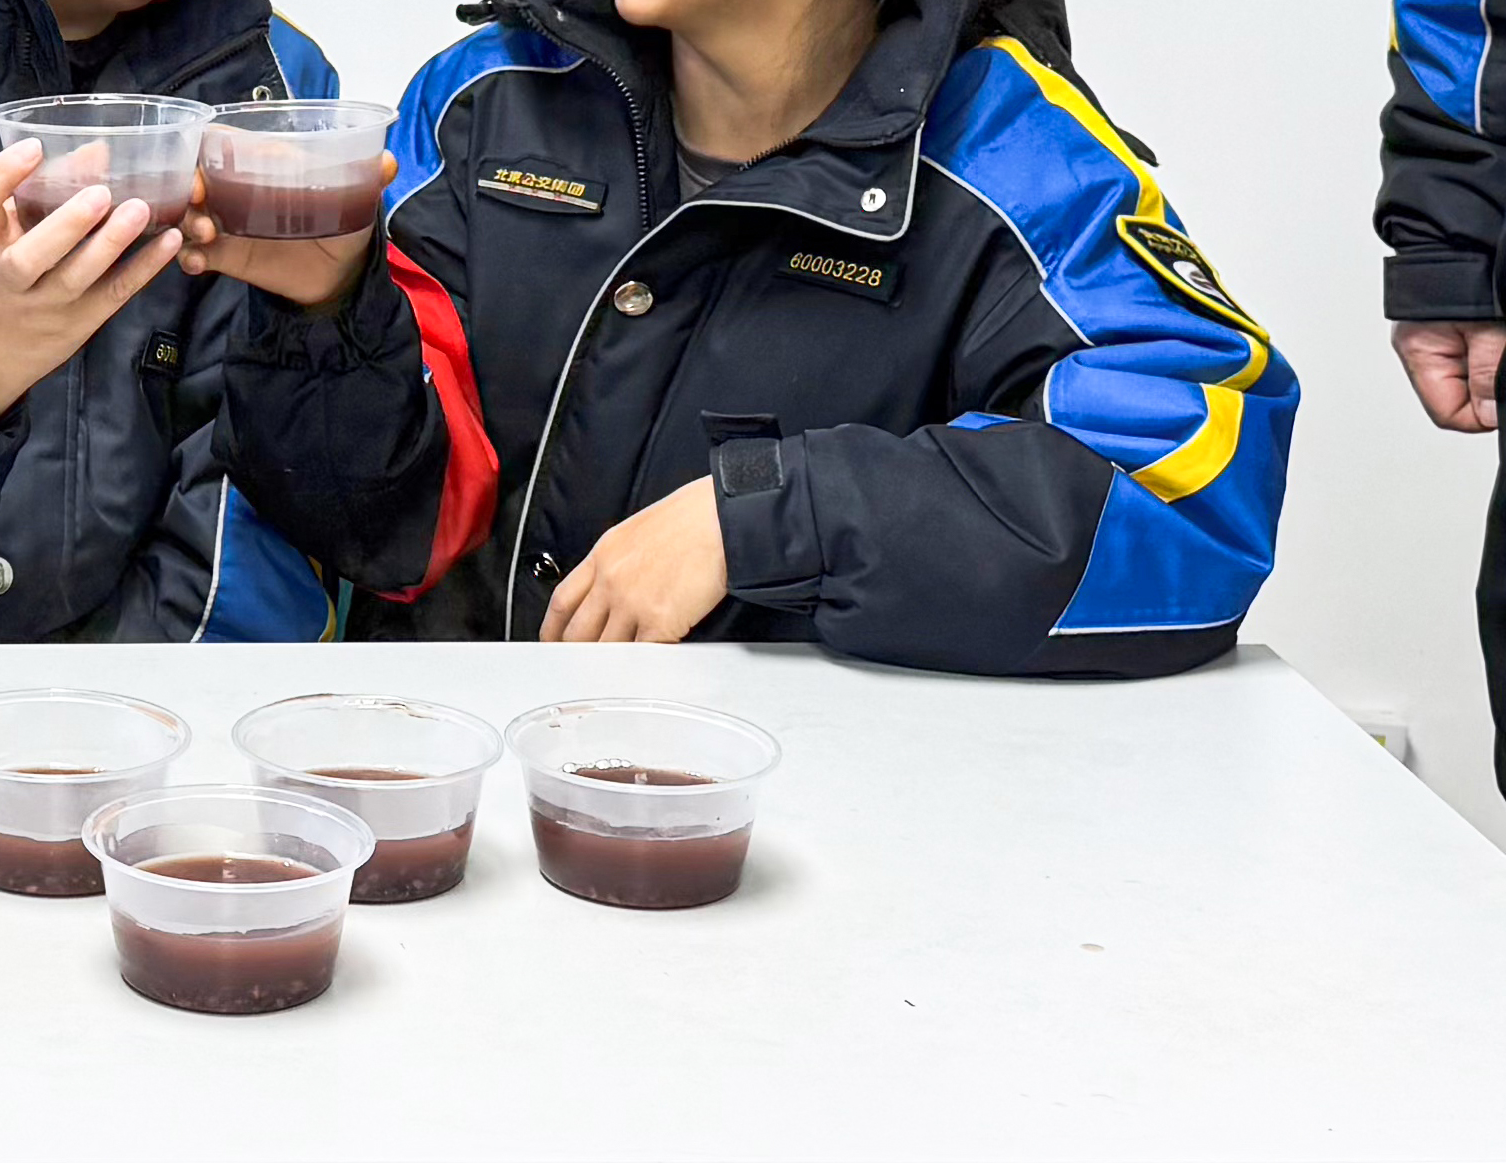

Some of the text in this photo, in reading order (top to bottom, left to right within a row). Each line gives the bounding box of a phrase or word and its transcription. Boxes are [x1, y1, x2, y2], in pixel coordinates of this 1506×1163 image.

[494, 168, 586, 197] 北京公交集团
[790, 252, 883, 287] 60003228
